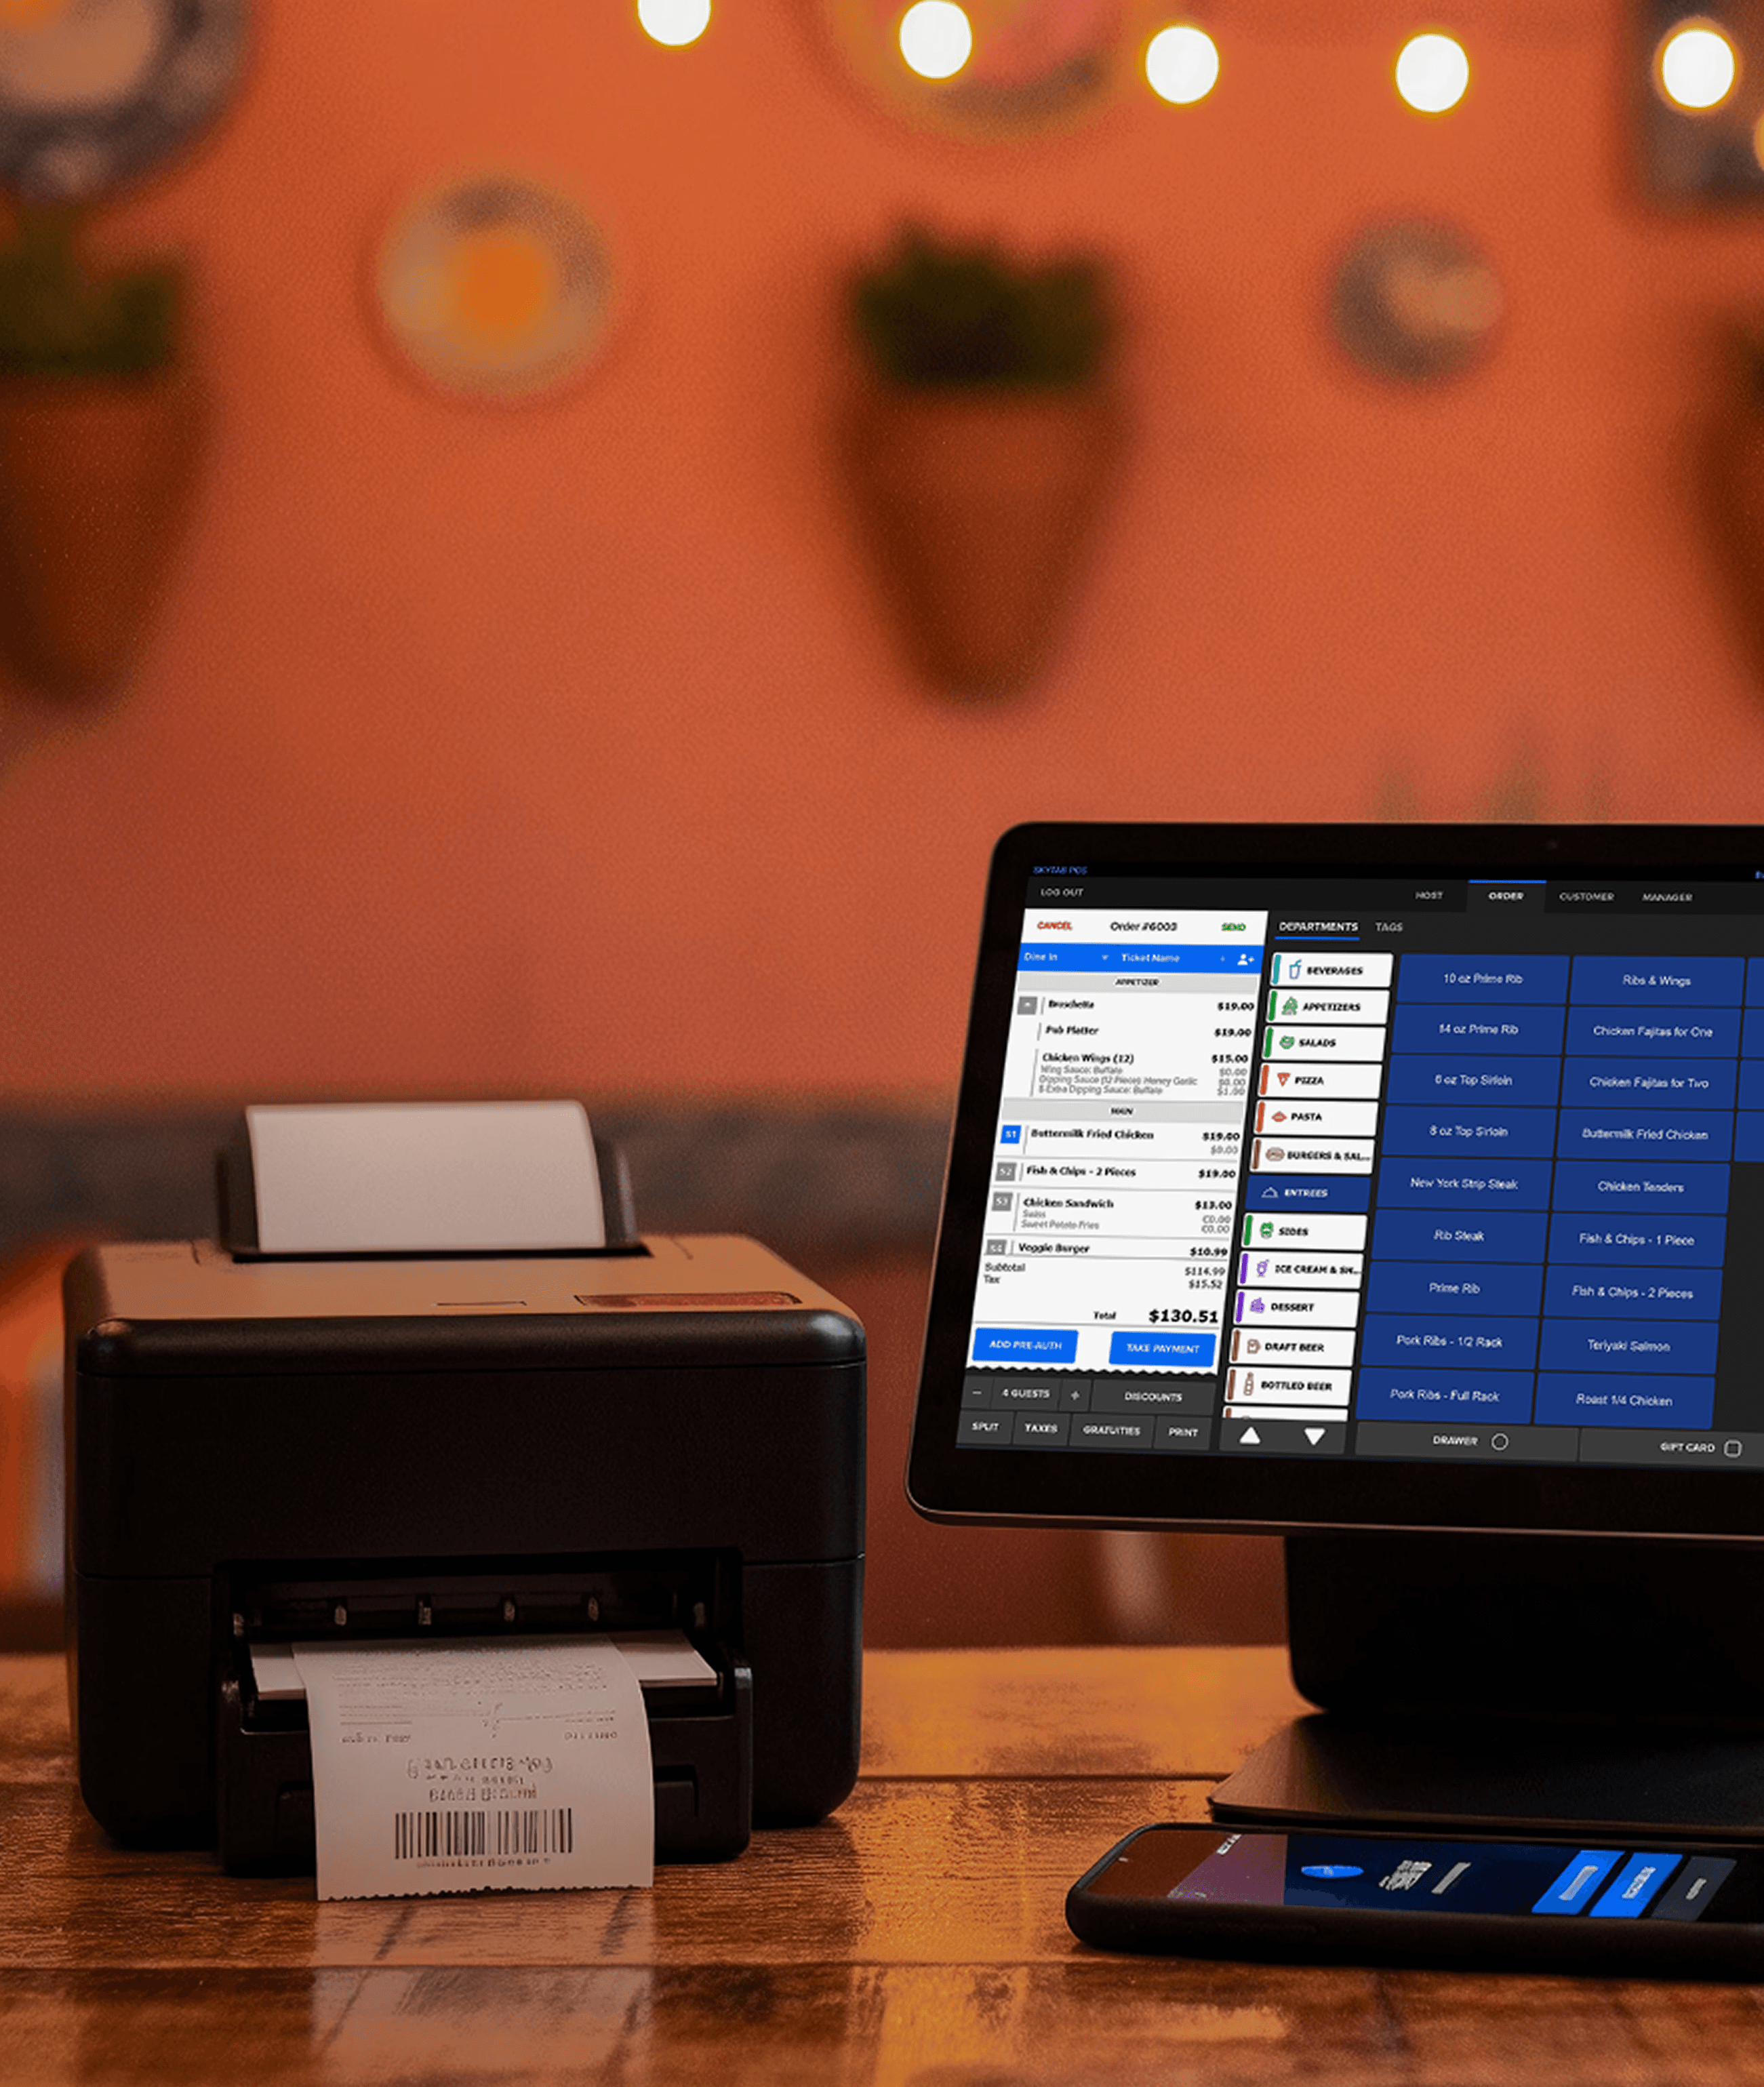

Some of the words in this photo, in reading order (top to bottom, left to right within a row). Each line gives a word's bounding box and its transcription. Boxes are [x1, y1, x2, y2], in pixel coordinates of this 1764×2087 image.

[1041, 888, 1060, 896] LOG
[1063, 888, 1083, 896] OUT
[1559, 892, 1614, 901] CUSTOMER
[1037, 921, 1072, 930] CANCEL
[1110, 921, 1140, 931] Order
[1279, 922, 1358, 931] DEPARTMENTS
[1376, 922, 1403, 932] TAGS
[1049, 953, 1058, 961] In
[1121, 953, 1150, 962] Ticket
[1307, 967, 1363, 975] BEVERAGES
[1445, 973, 1456, 983] 10
[1458, 975, 1470, 983] oz
[1474, 973, 1503, 983] Prime
[1506, 974, 1523, 983] Rib
[1623, 974, 1645, 985] Ribs
[1648, 976, 1656, 985] &
[1660, 976, 1691, 987] Wings
[1218, 1002, 1254, 1011] $19.00
[1303, 1003, 1361, 1011] APPETIZERS
[1045, 1026, 1064, 1034] Pub
[1066, 1026, 1099, 1035] Platter
[1214, 1028, 1251, 1037] $19.00
[1469, 1025, 1498, 1034] Prime
[1501, 1025, 1519, 1035] Rib
[1594, 1026, 1635, 1035] Chicken
[1638, 1027, 1672, 1038] Fajitas
[1675, 1027, 1688, 1037] for
[1690, 1027, 1712, 1037] One
[1299, 1039, 1336, 1047] SALADS
[1043, 1053, 1079, 1062] Chicken
[1081, 1054, 1110, 1065] Wings
[1295, 1077, 1323, 1085] PIZZA
[1444, 1077, 1457, 1085] oz
[1460, 1075, 1478, 1086] Top
[1481, 1075, 1512, 1086] Sirloin
[1590, 1077, 1631, 1087] Chicken
[1634, 1077, 1668, 1089] Fajitas
[1671, 1078, 1685, 1088] for
[1688, 1078, 1708, 1088] Two
[1291, 1113, 1322, 1121] PASTA
[1031, 1129, 1083, 1138] Buttermilk
[1087, 1129, 1112, 1138] Fried
[1115, 1130, 1154, 1139] Chicken
[1203, 1132, 1240, 1140] $19.00
[1439, 1128, 1452, 1136] oz
[1456, 1126, 1473, 1137] Top
[1476, 1127, 1508, 1136] Sirloin
[1582, 1128, 1634, 1138] Buttermilk
[1637, 1129, 1663, 1139] Fried
[1666, 1129, 1708, 1140] Chicken
[1287, 1151, 1331, 1159] BURGERS
[1334, 1152, 1342, 1160] &
[1026, 1166, 1047, 1174] Fish
[1049, 1167, 1058, 1175] &
[1059, 1167, 1086, 1177] Chips
[1096, 1167, 1102, 1176] 2
[1104, 1167, 1136, 1176] Pieces
[1199, 1170, 1236, 1178] $19.00
[1411, 1178, 1434, 1187] New
[1437, 1178, 1459, 1187] York
[1488, 1179, 1518, 1189] Steak
[1598, 1181, 1640, 1191] Chicken
[1643, 1182, 1684, 1192] Tenders
[1285, 1189, 1327, 1197] ENTREES
[1023, 1198, 1063, 1207] Chicken
[1066, 1199, 1114, 1208] Sandwich
[1434, 1230, 1452, 1240] Rib
[1455, 1231, 1484, 1241] Steak
[1580, 1233, 1602, 1243] Fish
[1604, 1233, 1612, 1244] &
[1616, 1233, 1645, 1246] Chips
[1657, 1235, 1661, 1244] 1
[1665, 1235, 1694, 1246] Piece
[1019, 1243, 1053, 1253] Veggie
[1056, 1244, 1089, 1254] Burger
[1190, 1248, 1228, 1256] $10.99
[1294, 1265, 1327, 1273] CREAM
[1430, 1283, 1459, 1293] Prime
[1462, 1284, 1480, 1294] Rib
[1572, 1286, 1595, 1296] Fish
[1598, 1287, 1605, 1296] &
[1608, 1287, 1638, 1299] Chips
[1648, 1288, 1656, 1298] 2
[1658, 1288, 1693, 1298] Pieces
[1271, 1303, 1314, 1311] DESSERT
[1094, 1311, 1116, 1319] Total
[1149, 1309, 1218, 1323] $130.51
[989, 1339, 1011, 1349] ADD
[1397, 1335, 1421, 1345] Pork
[1424, 1335, 1447, 1346] Ribs
[1476, 1337, 1502, 1347] Rack
[1588, 1339, 1627, 1352] Teriyaki
[1630, 1341, 1670, 1351] Salmon
[1153, 1345, 1199, 1353] PAYMENT
[1265, 1343, 1297, 1351] DRAFT
[1299, 1343, 1324, 1351] BEER
[1261, 1381, 1304, 1390] BOTTLED
[1307, 1382, 1332, 1391] BEER
[1011, 1389, 1049, 1397] GUESTS
[1125, 1392, 1182, 1402] DISCOUNTS
[1390, 1389, 1414, 1399] Pork
[1418, 1389, 1441, 1399] Ribs
[1450, 1390, 1470, 1400] Full
[1472, 1391, 1500, 1402] Rack
[1576, 1393, 1607, 1404] Roast
[1630, 1395, 1672, 1406] Chicken
[972, 1423, 999, 1431] SPLIT
[1026, 1424, 1057, 1433] TAXES
[1169, 1428, 1198, 1437] PRINT
[1433, 1435, 1478, 1445] DRAWER
[1660, 1442, 1684, 1451] GIFT
[1686, 1444, 1715, 1452] CARD
